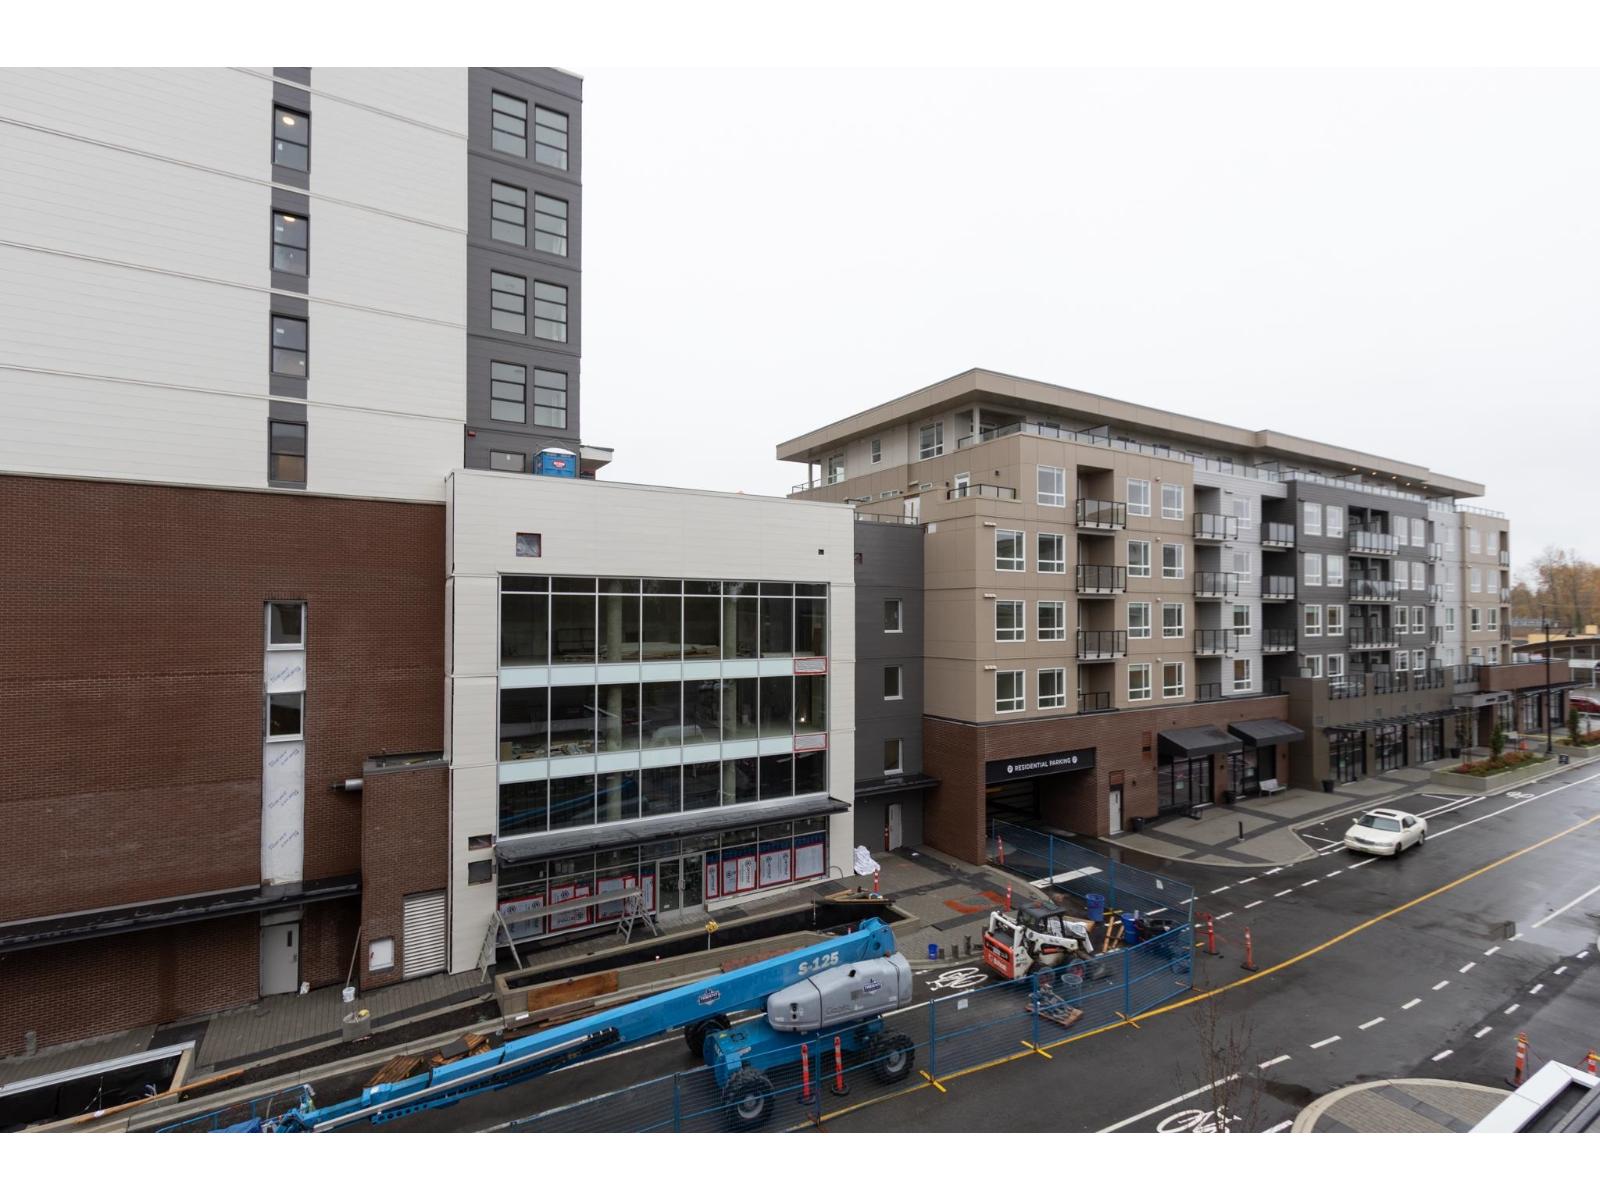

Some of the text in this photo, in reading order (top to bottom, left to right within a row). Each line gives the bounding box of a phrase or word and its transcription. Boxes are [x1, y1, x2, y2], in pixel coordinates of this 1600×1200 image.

[1014, 762, 1048, 771] RESIDENTIAL
[1049, 757, 1071, 766] PARKING
[798, 951, 839, 975] S-125
